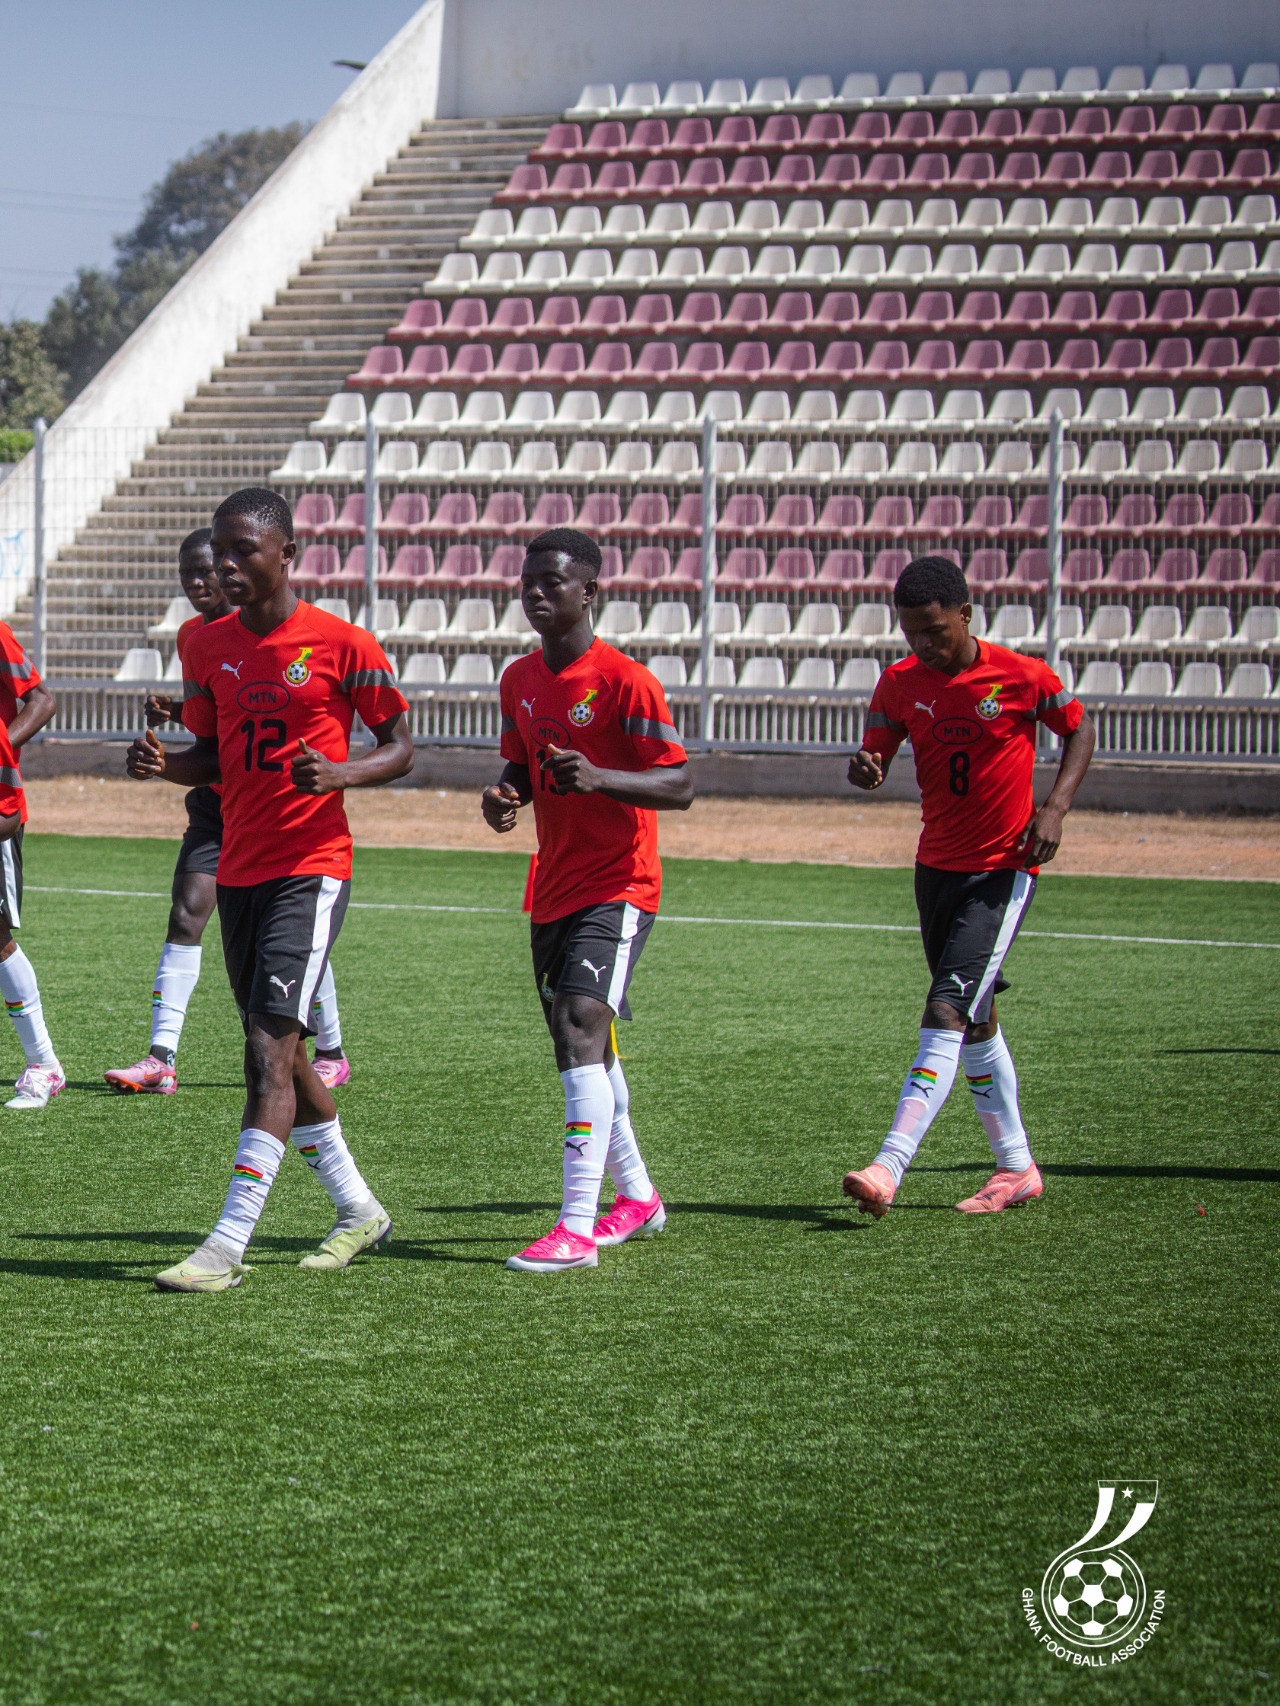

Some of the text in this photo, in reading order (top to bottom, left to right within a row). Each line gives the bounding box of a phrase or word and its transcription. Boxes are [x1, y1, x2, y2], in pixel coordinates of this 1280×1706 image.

[248, 691, 277, 704] MTN
[538, 726, 561, 742] MTN
[943, 726, 970, 737] MTN
[240, 717, 287, 772] 12
[949, 751, 970, 797] 8
